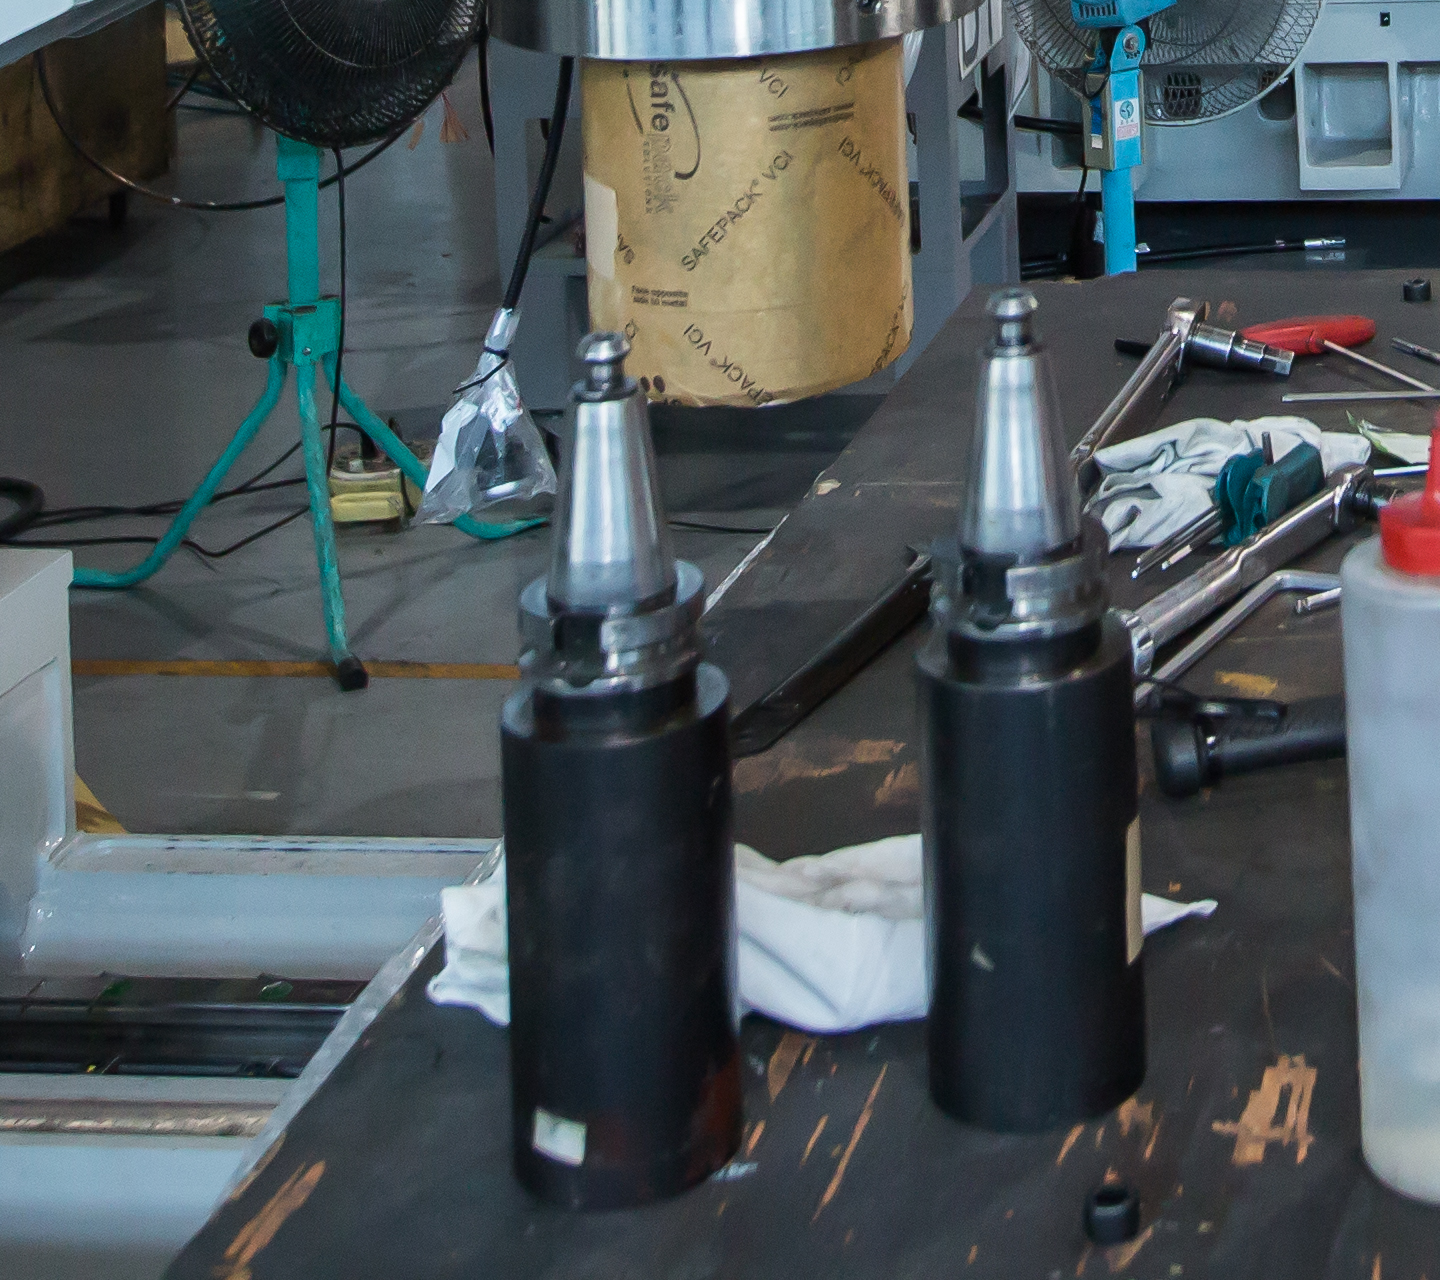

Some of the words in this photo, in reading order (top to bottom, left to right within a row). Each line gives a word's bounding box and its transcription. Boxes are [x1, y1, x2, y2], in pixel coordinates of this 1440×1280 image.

[759, 67, 791, 99] VCI
[762, 150, 795, 182] VCI
[683, 323, 713, 357] VCI
